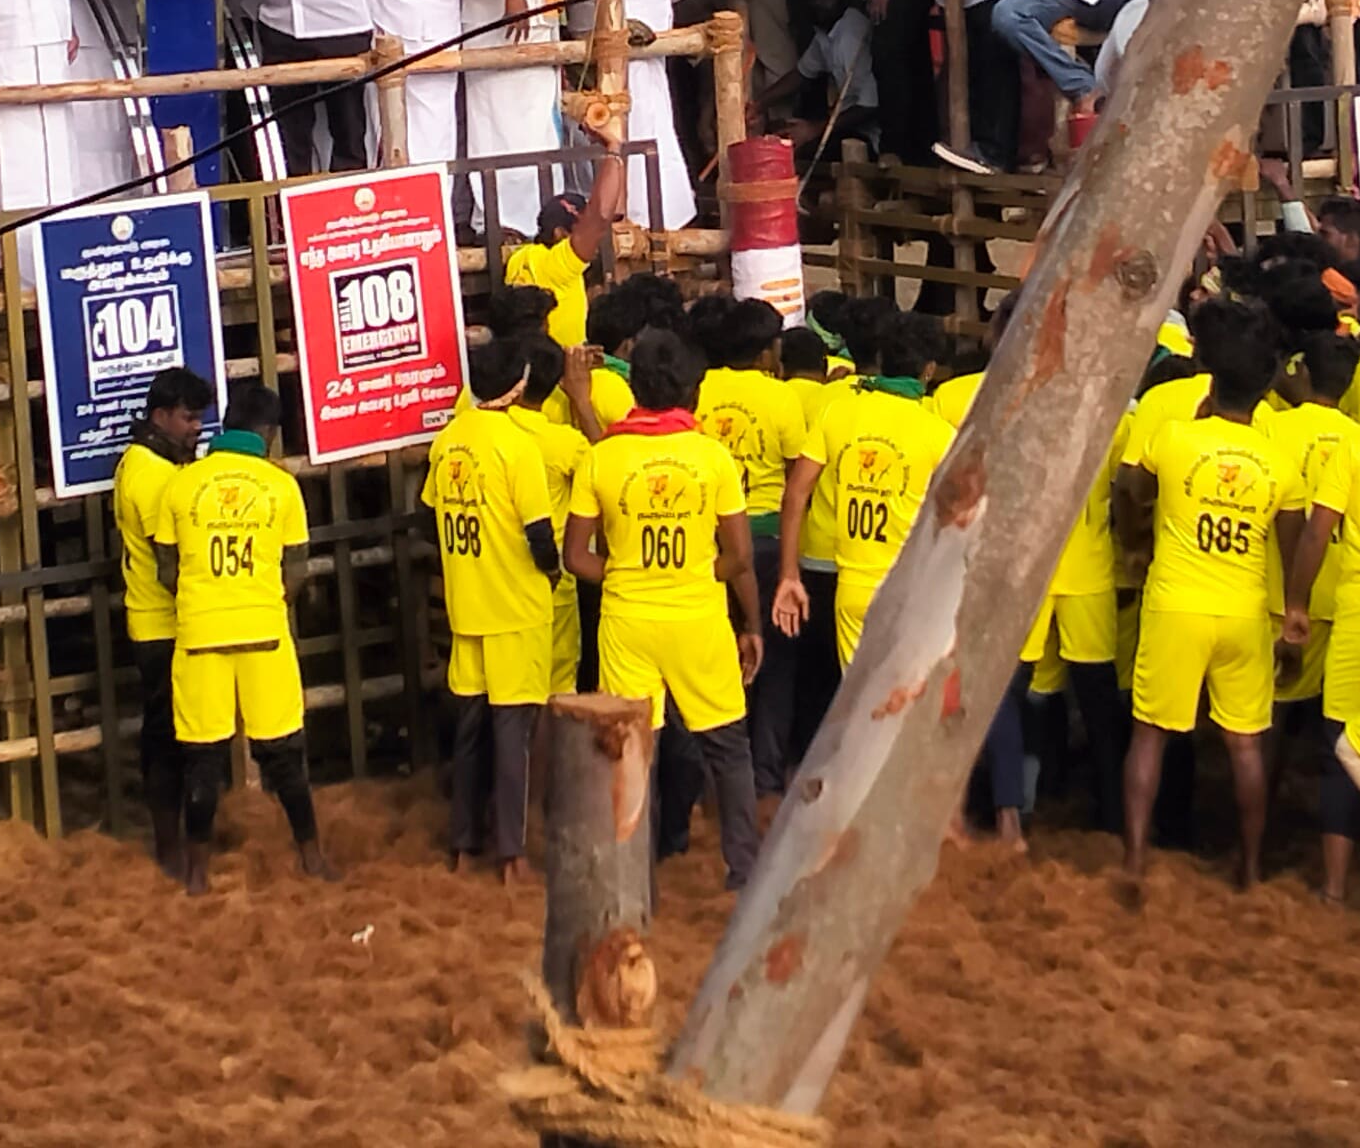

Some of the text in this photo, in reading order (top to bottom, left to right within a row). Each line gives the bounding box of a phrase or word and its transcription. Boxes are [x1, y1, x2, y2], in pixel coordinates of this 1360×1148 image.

[340, 270, 415, 330] 108
[99, 294, 176, 357] 104
[326, 378, 355, 400] 24
[444, 512, 481, 558] 098
[847, 497, 888, 544] 002
[1197, 513, 1251, 555] 085
[210, 535, 254, 577] 054
[642, 524, 686, 569] 060
